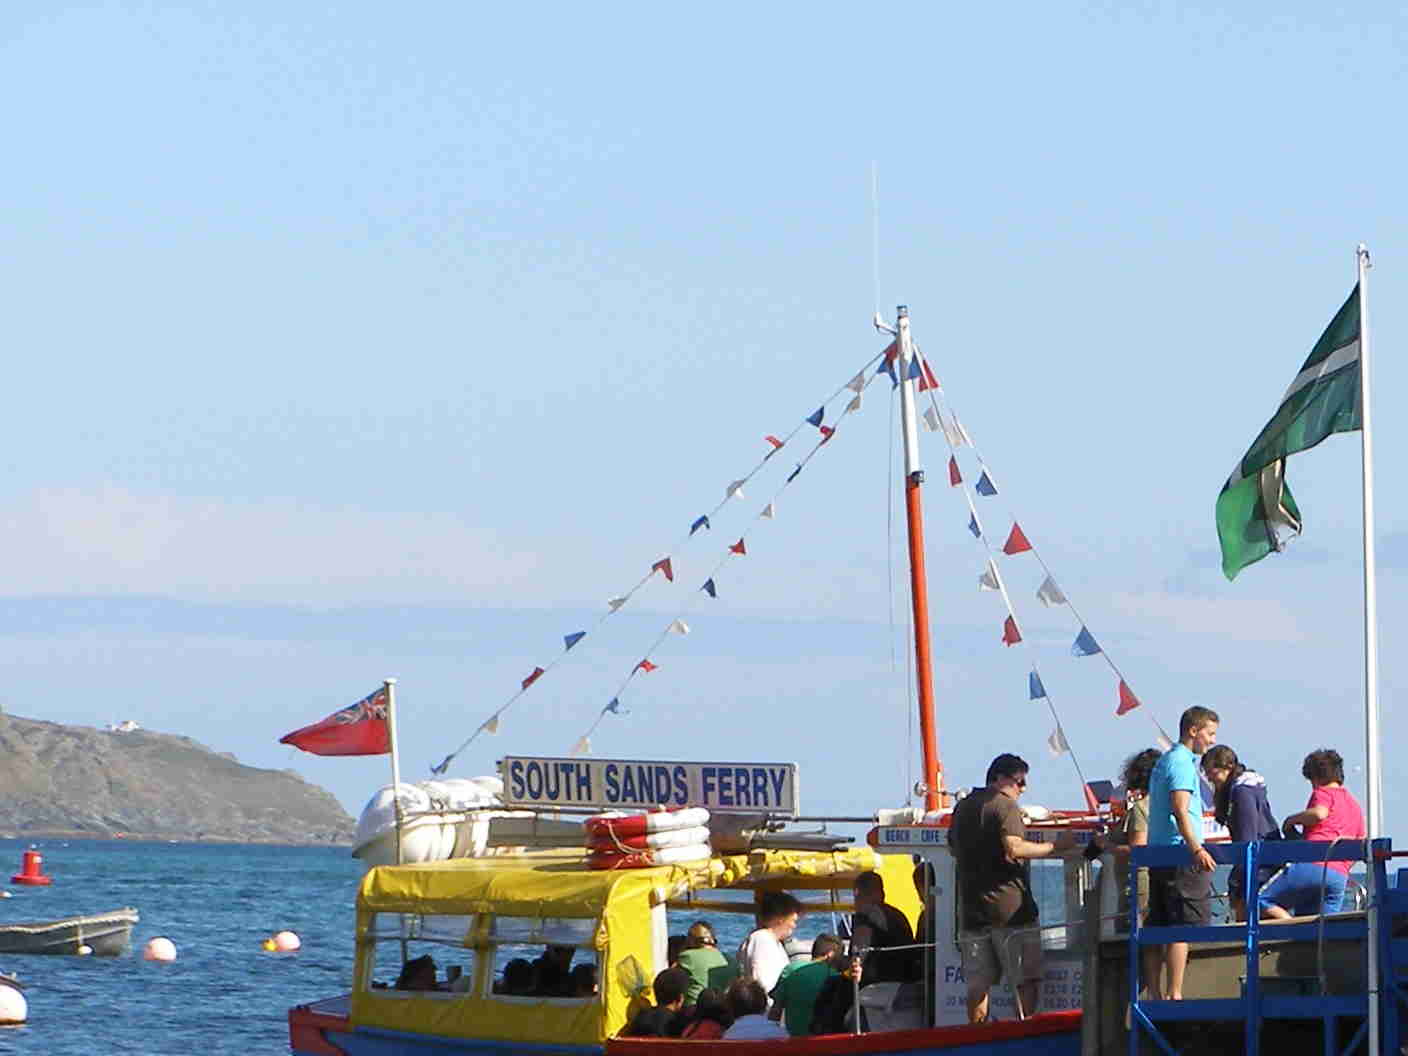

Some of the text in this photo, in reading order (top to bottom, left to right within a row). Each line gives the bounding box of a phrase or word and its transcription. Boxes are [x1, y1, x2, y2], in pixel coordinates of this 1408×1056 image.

[511, 760, 786, 806] SOUTH SANDS FERRY
[886, 829, 939, 843] BEACH CAFE
